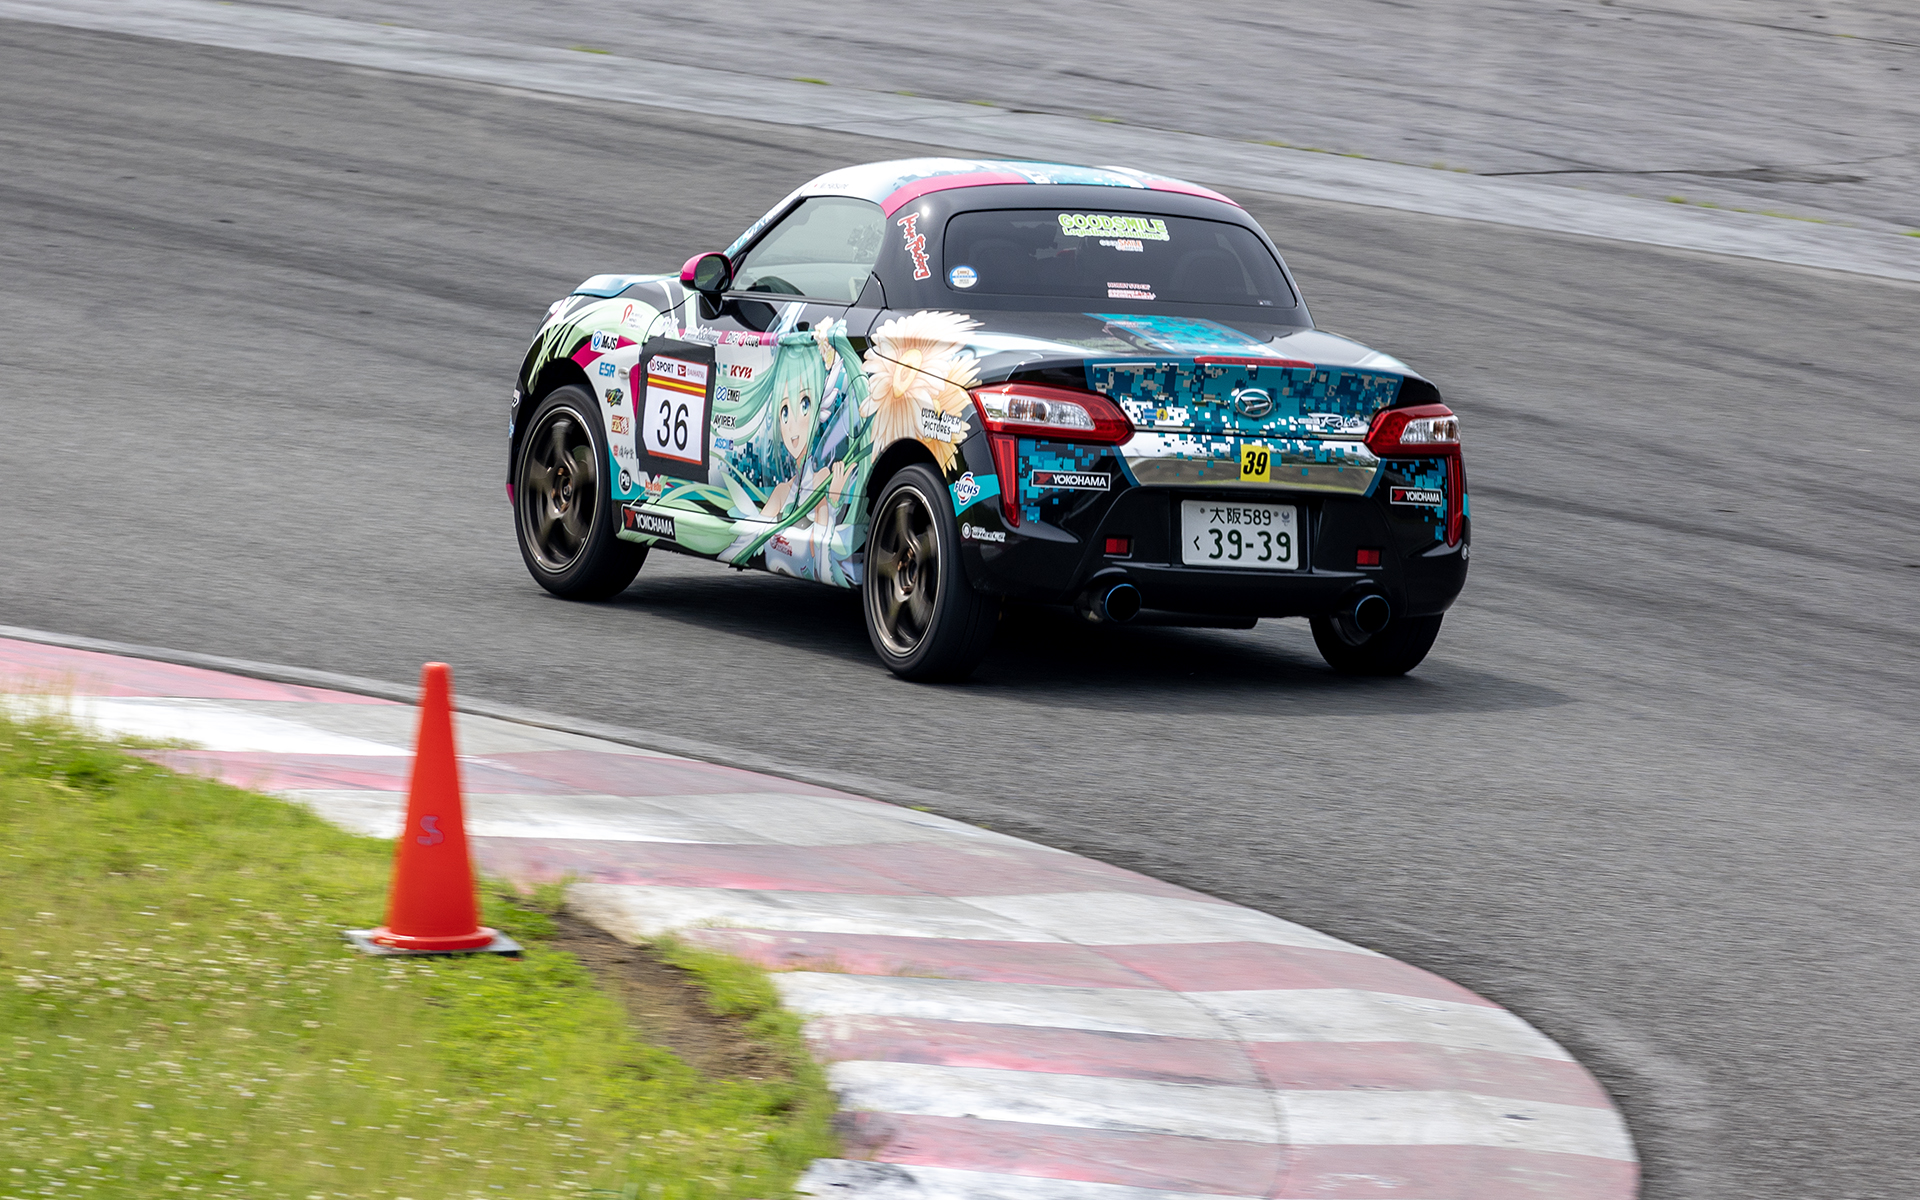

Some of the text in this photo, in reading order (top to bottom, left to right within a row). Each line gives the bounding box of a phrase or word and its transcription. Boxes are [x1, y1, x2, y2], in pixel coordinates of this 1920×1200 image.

[1059, 214, 1166, 236] GOODSMILE
[599, 362, 616, 378] ESR
[656, 361, 674, 374] SPORT
[730, 364, 752, 379] KYB
[656, 399, 689, 451] 36
[923, 420, 951, 436] PICTURES
[1243, 451, 1269, 475] 39
[954, 482, 978, 495] FUCHS
[1052, 474, 1107, 487] YOKOHAMA
[1405, 490, 1440, 503] YOKOHAMA
[635, 513, 674, 536] YOKOHAMA
[1193, 527, 1291, 563] く 39-39
